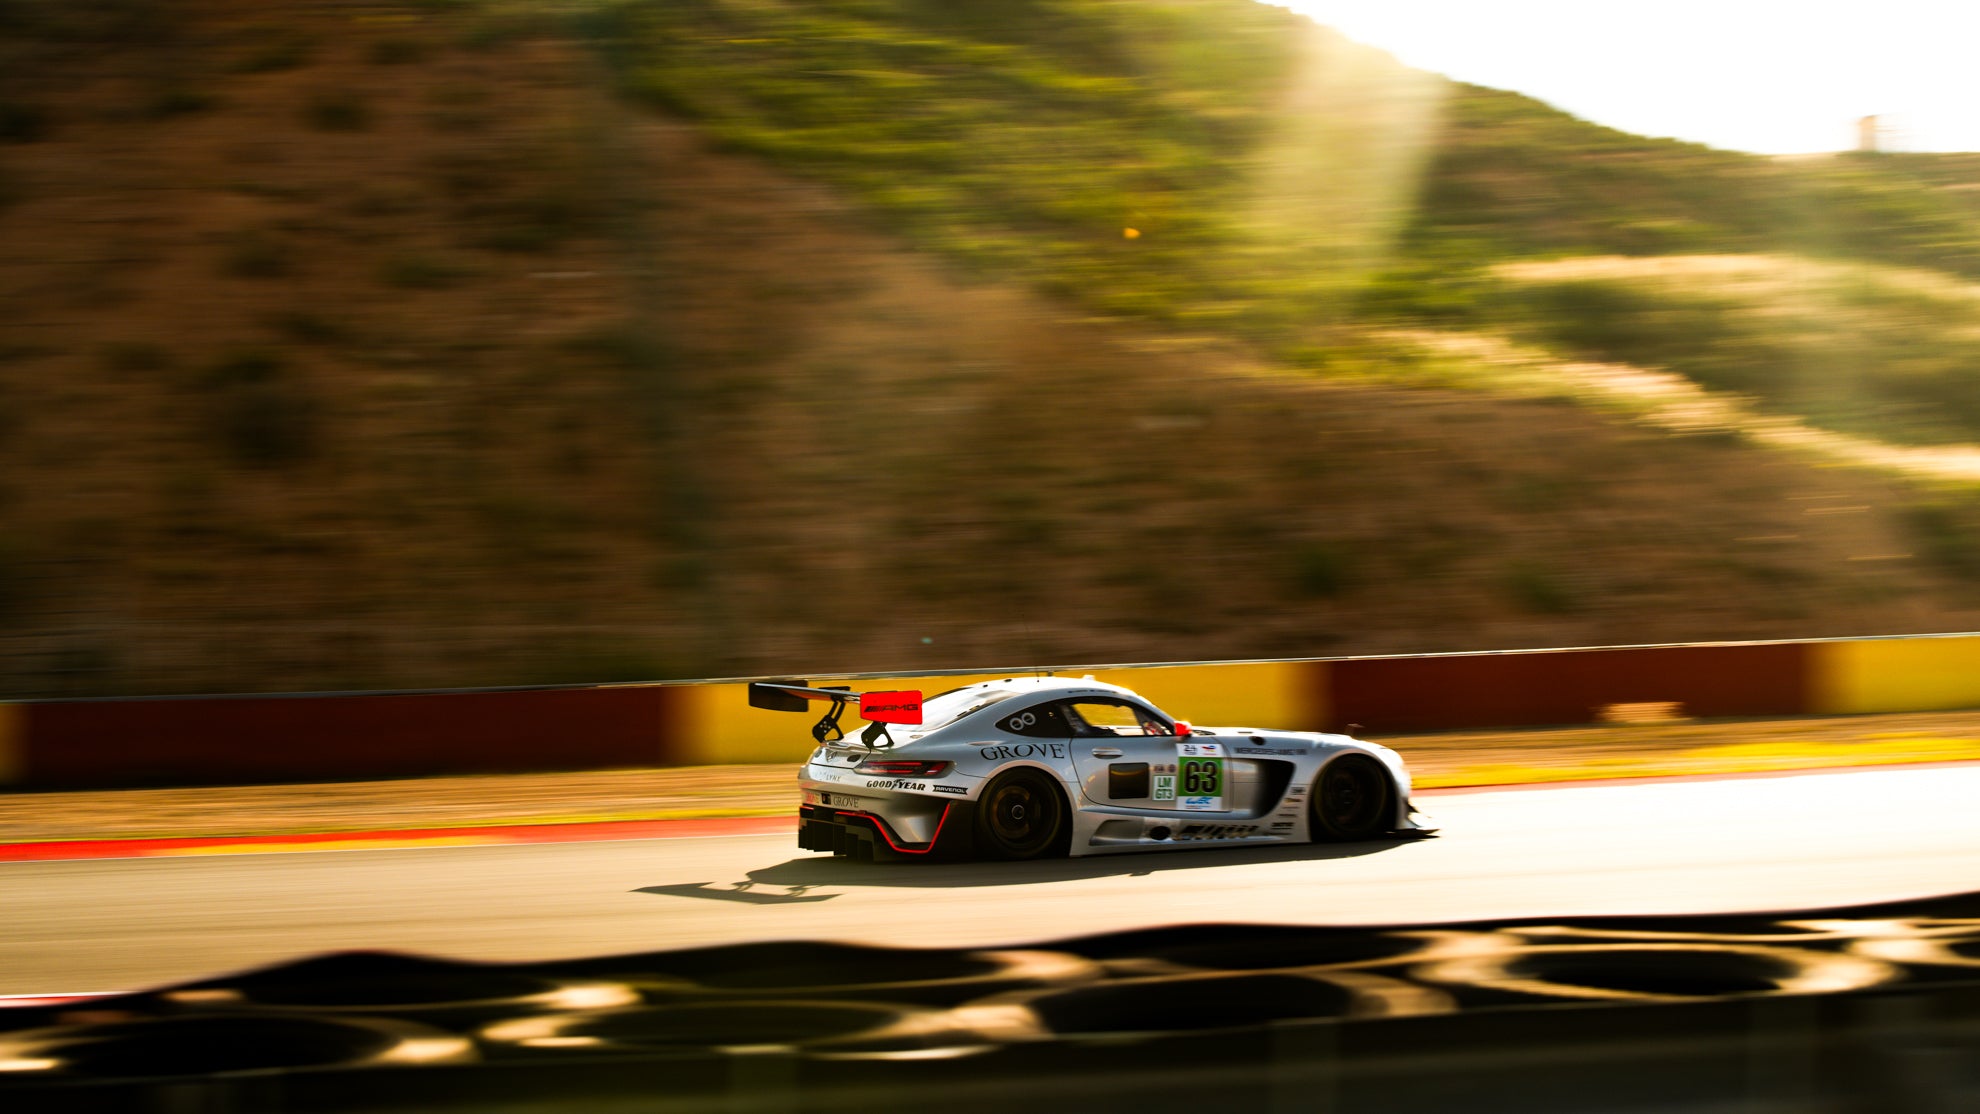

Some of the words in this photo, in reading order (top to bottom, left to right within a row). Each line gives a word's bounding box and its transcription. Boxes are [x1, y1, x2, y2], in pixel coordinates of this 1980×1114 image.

[980, 743, 1065, 760] GROVE
[1158, 777, 1172, 787] LM
[1185, 761, 1217, 793] 63
[866, 779, 926, 791] GOODYEAR
[935, 786, 966, 794] RAVENOL
[1155, 788, 1173, 799] GT3
[833, 796, 859, 808] GROVE
